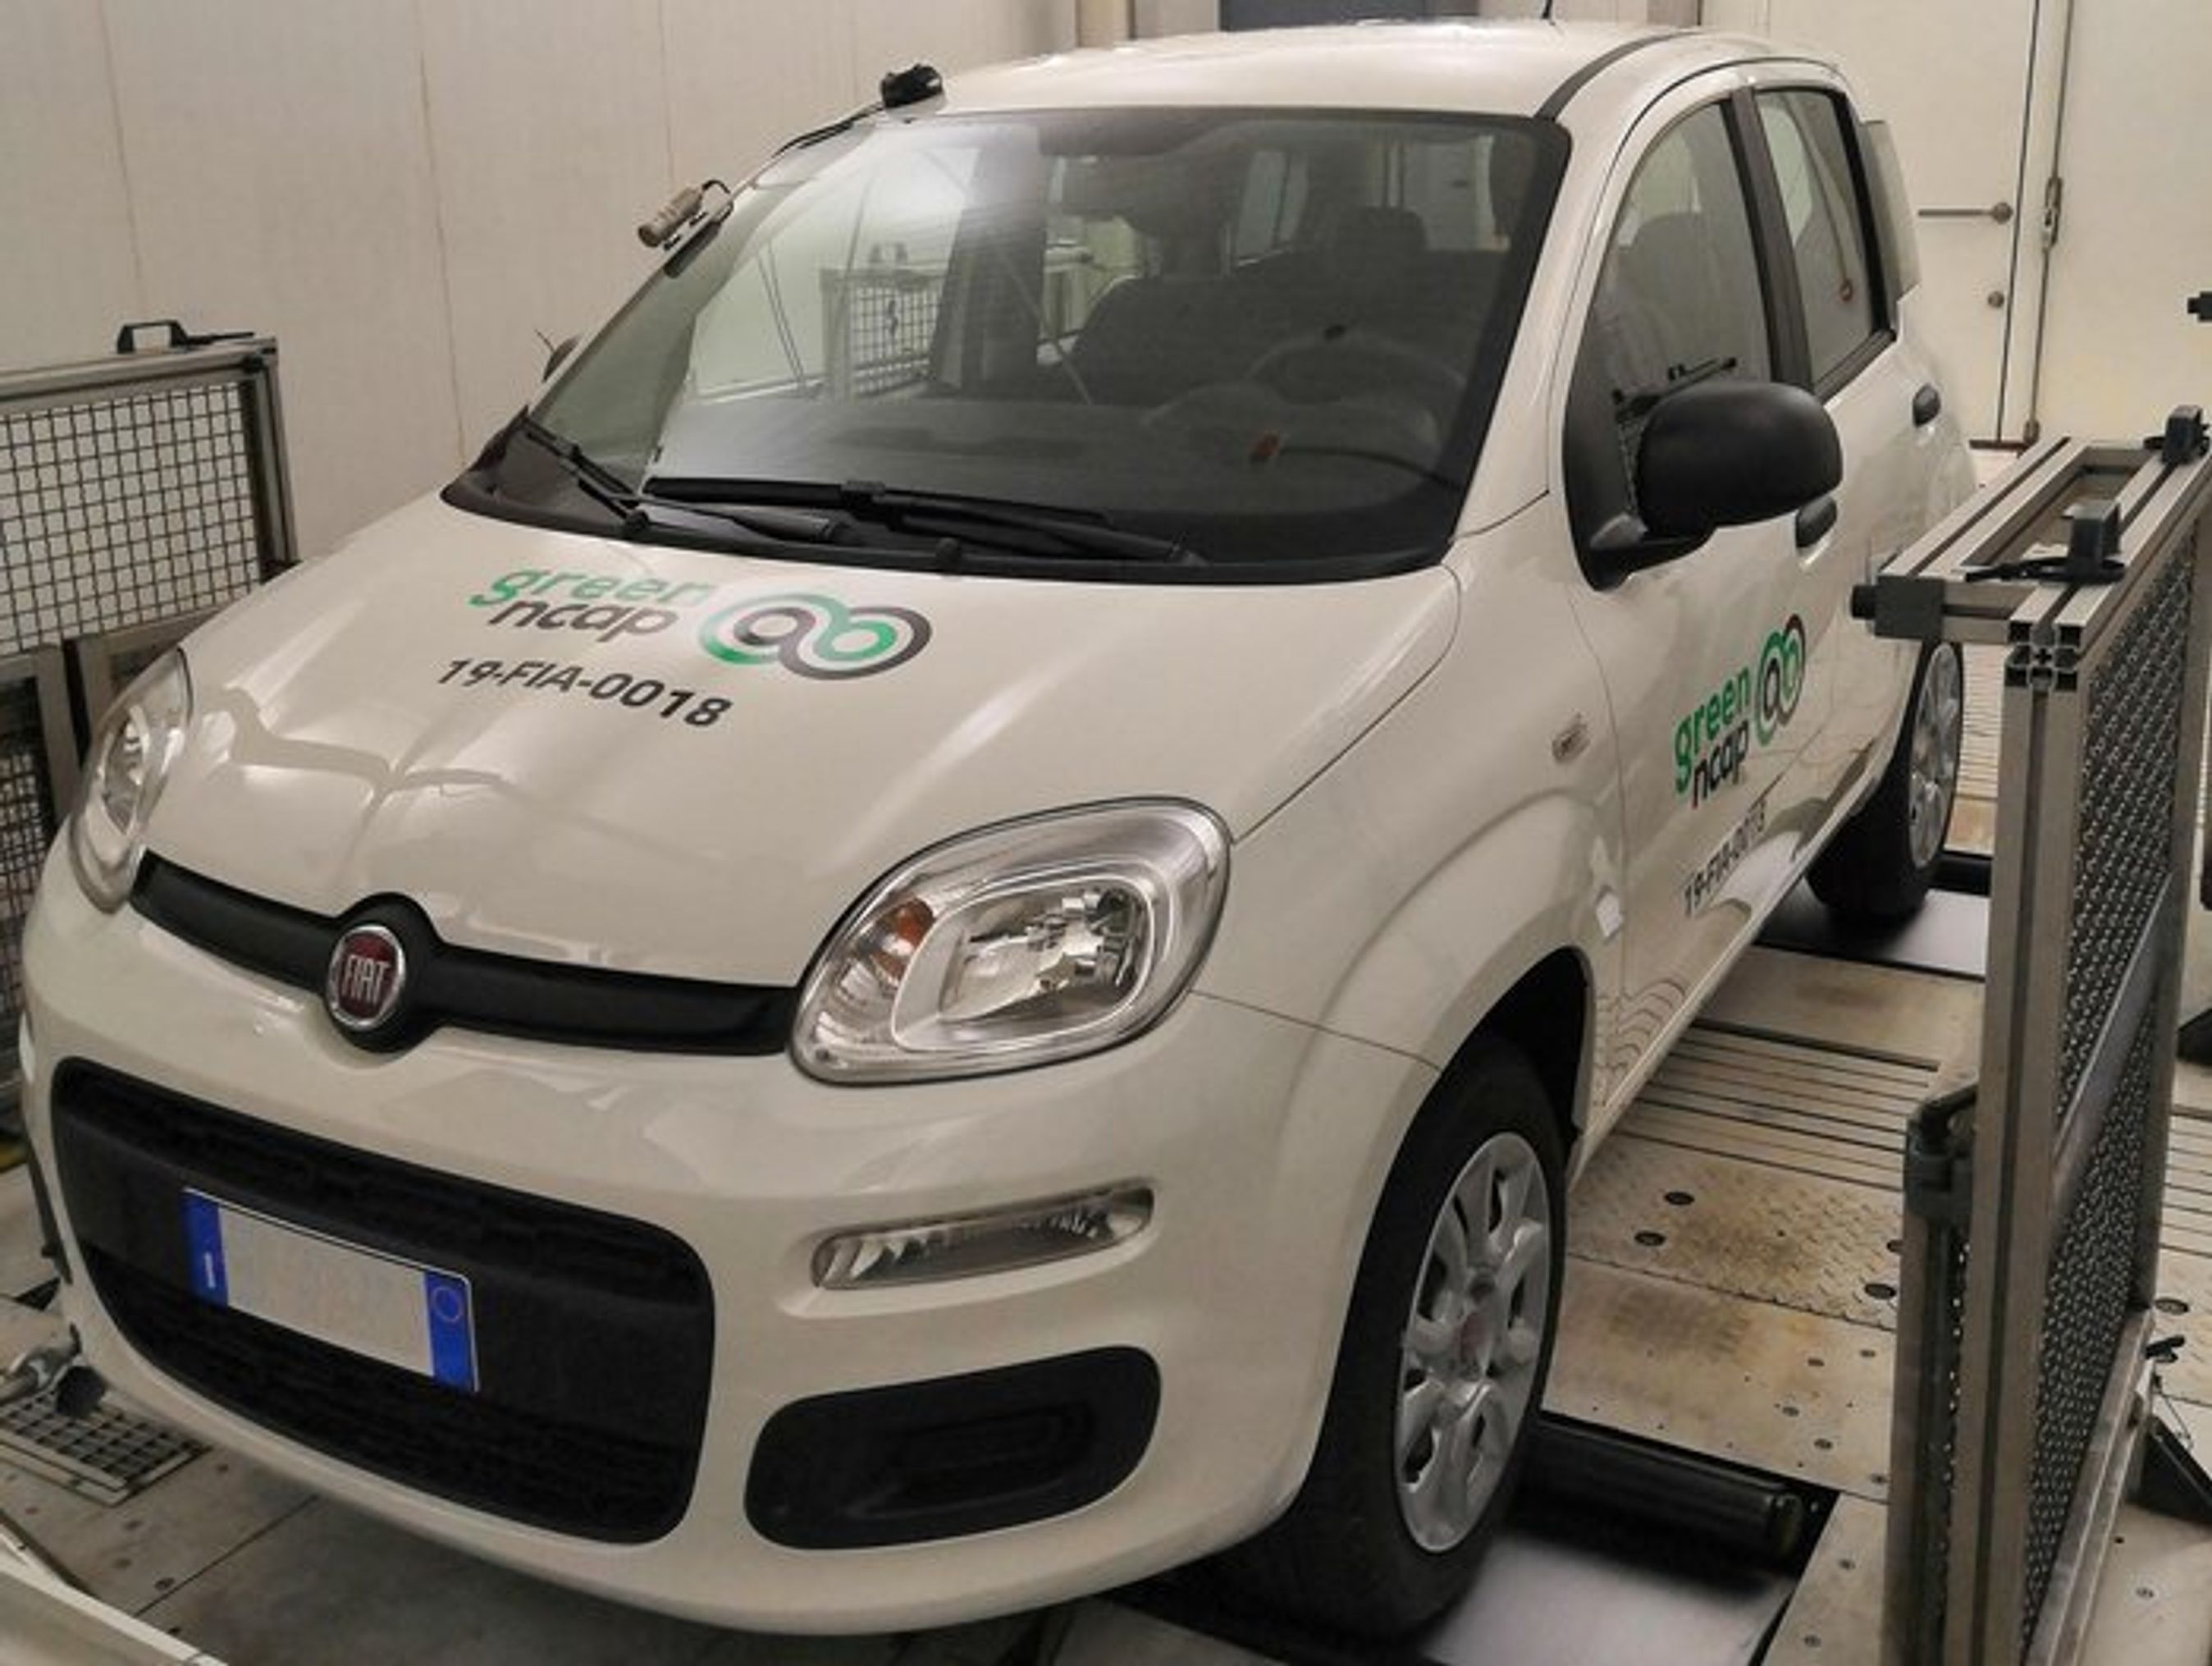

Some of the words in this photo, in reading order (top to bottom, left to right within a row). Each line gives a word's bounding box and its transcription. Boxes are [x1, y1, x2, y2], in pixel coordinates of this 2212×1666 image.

[468, 570, 715, 606] green
[487, 601, 679, 643] ncap
[438, 658, 733, 726] 19-FIA-0018
[1675, 667, 1750, 794] green
[1691, 719, 1748, 809] ncap
[340, 954, 391, 1005] FIAT
